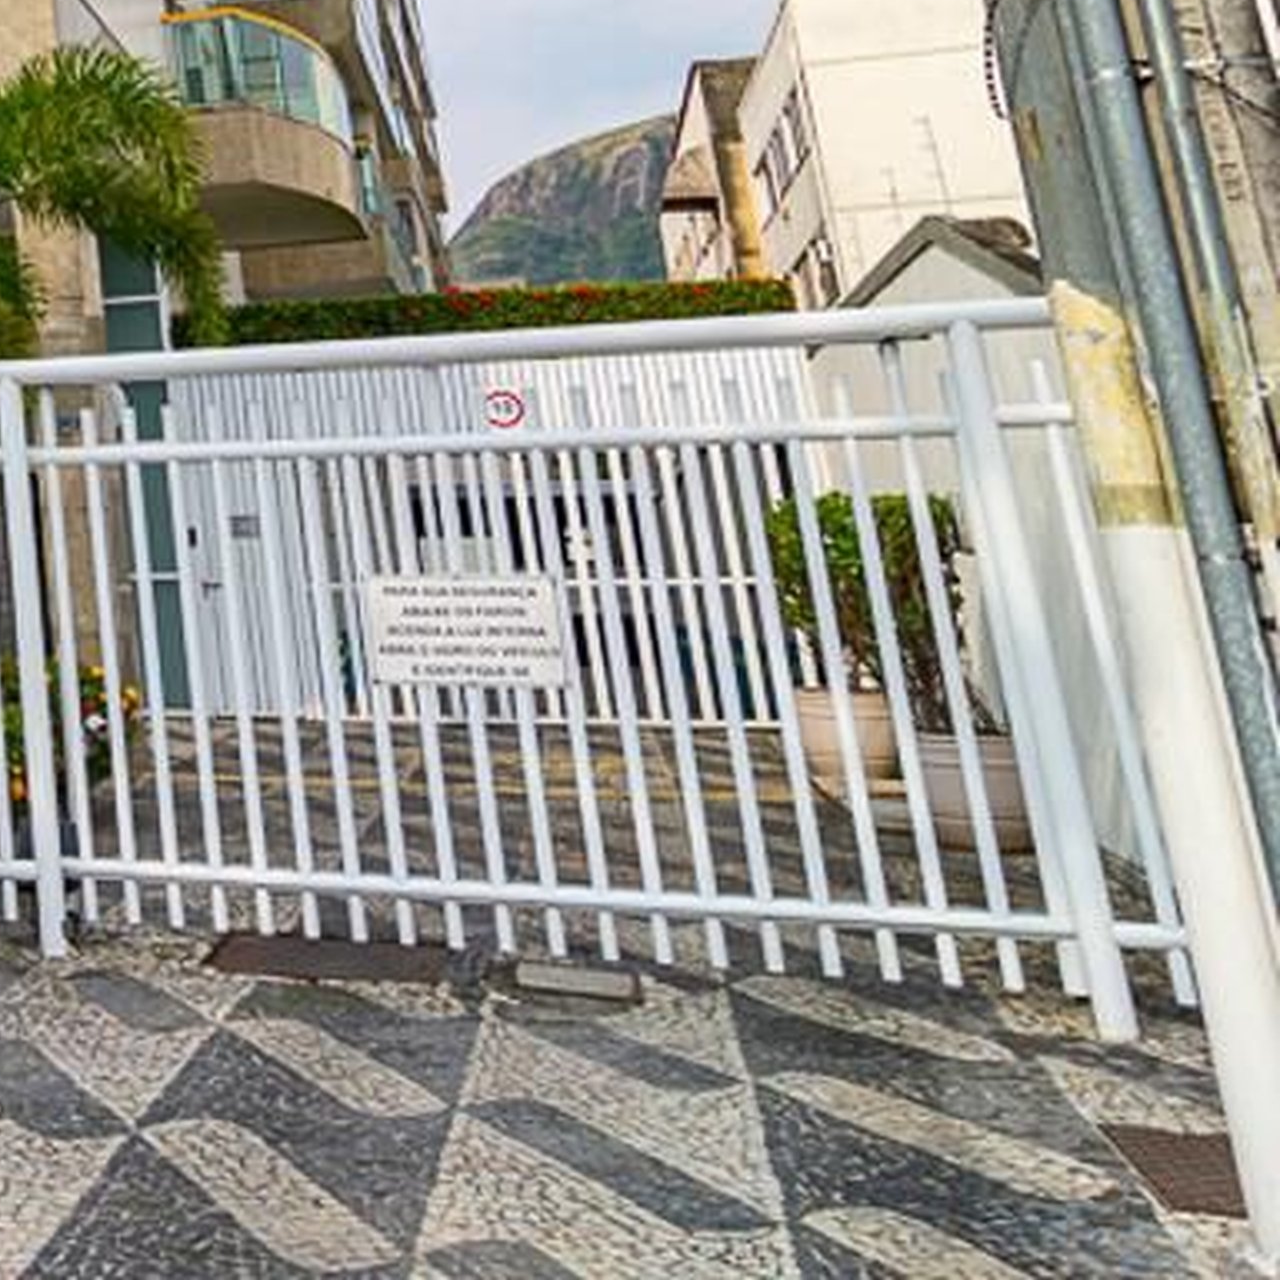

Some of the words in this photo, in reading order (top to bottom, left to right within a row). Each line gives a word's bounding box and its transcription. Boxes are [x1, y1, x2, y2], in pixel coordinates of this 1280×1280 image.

[382, 586, 418, 597] PARA
[422, 586, 449, 597] SUA
[452, 586, 537, 599] SEGURANÇA
[387, 626, 442, 637] ACENDA
[486, 626, 547, 637] INTERNA
